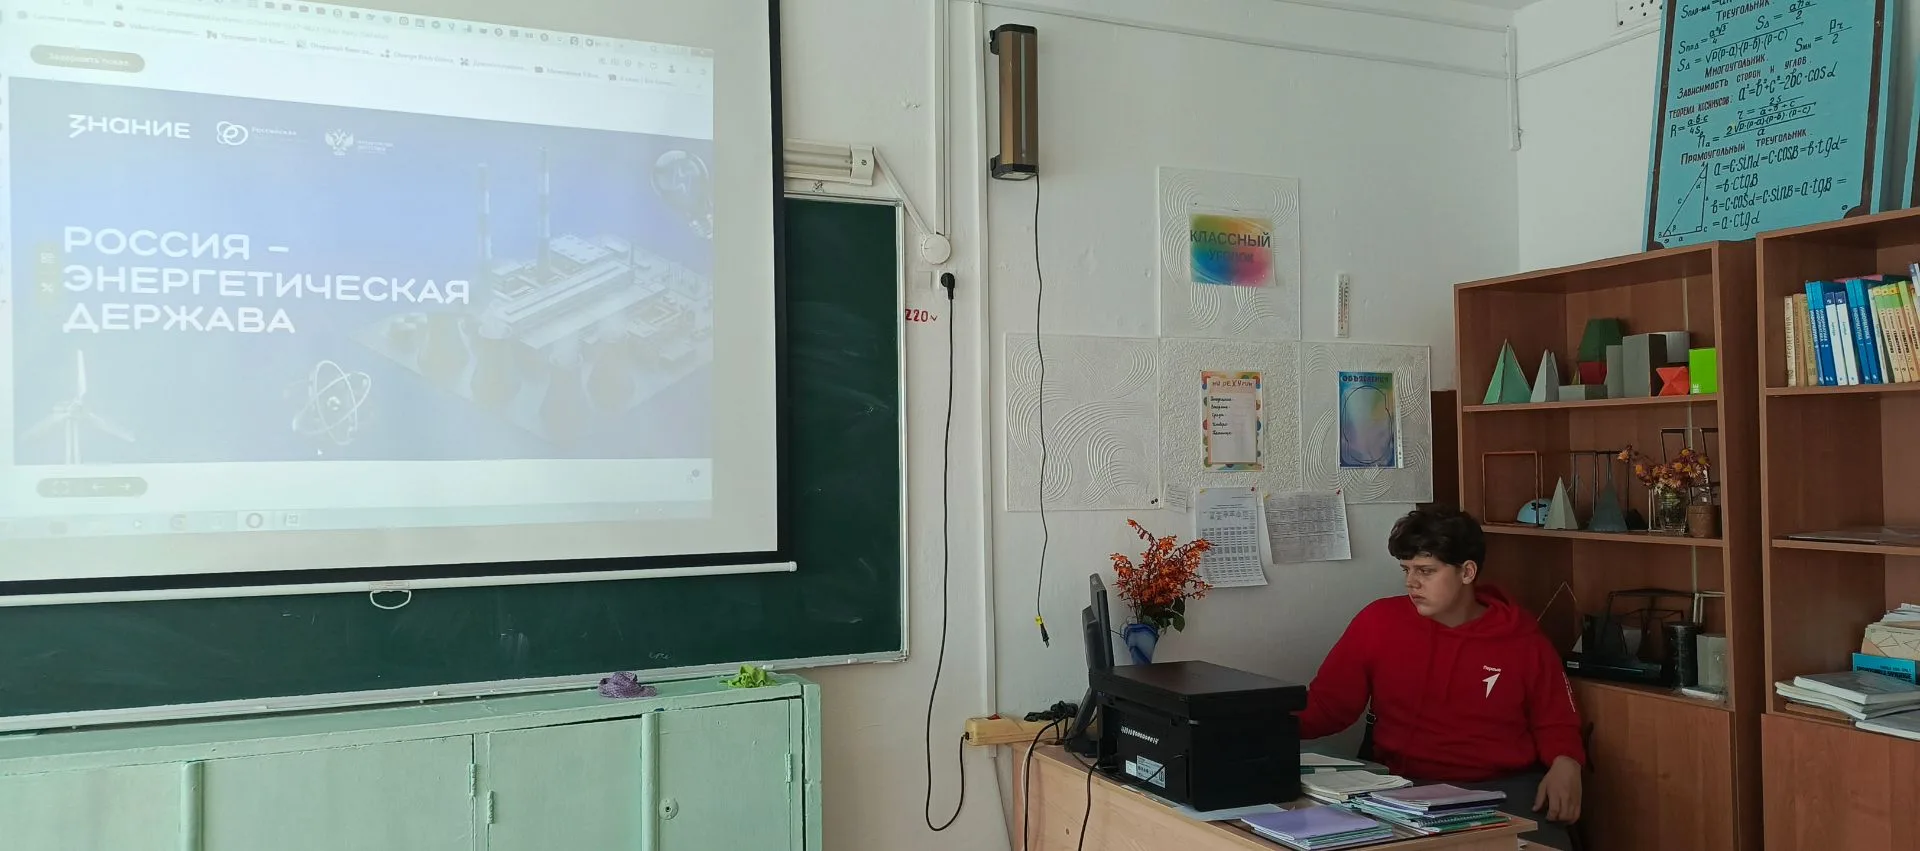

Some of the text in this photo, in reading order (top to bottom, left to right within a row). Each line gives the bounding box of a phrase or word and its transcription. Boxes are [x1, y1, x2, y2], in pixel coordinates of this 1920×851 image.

[1676, 78, 1729, 100] ЗАВИСИМОСТЬ
[1736, 69, 1761, 83] СТОРОН
[1669, 105, 1695, 119] ТЕОРЕМА
[1680, 140, 1747, 166] ПРЯМОУГОЛЬНЫЙ
[64, 226, 250, 261] РОССИЯ
[1190, 230, 1271, 249] КЛАССНЫЙ
[1208, 249, 1255, 263] УГОЛОК
[63, 264, 470, 304] ЭНЕРГЕТИЧЕСКАЯ
[62, 302, 296, 334] ДЕРЖАВА
